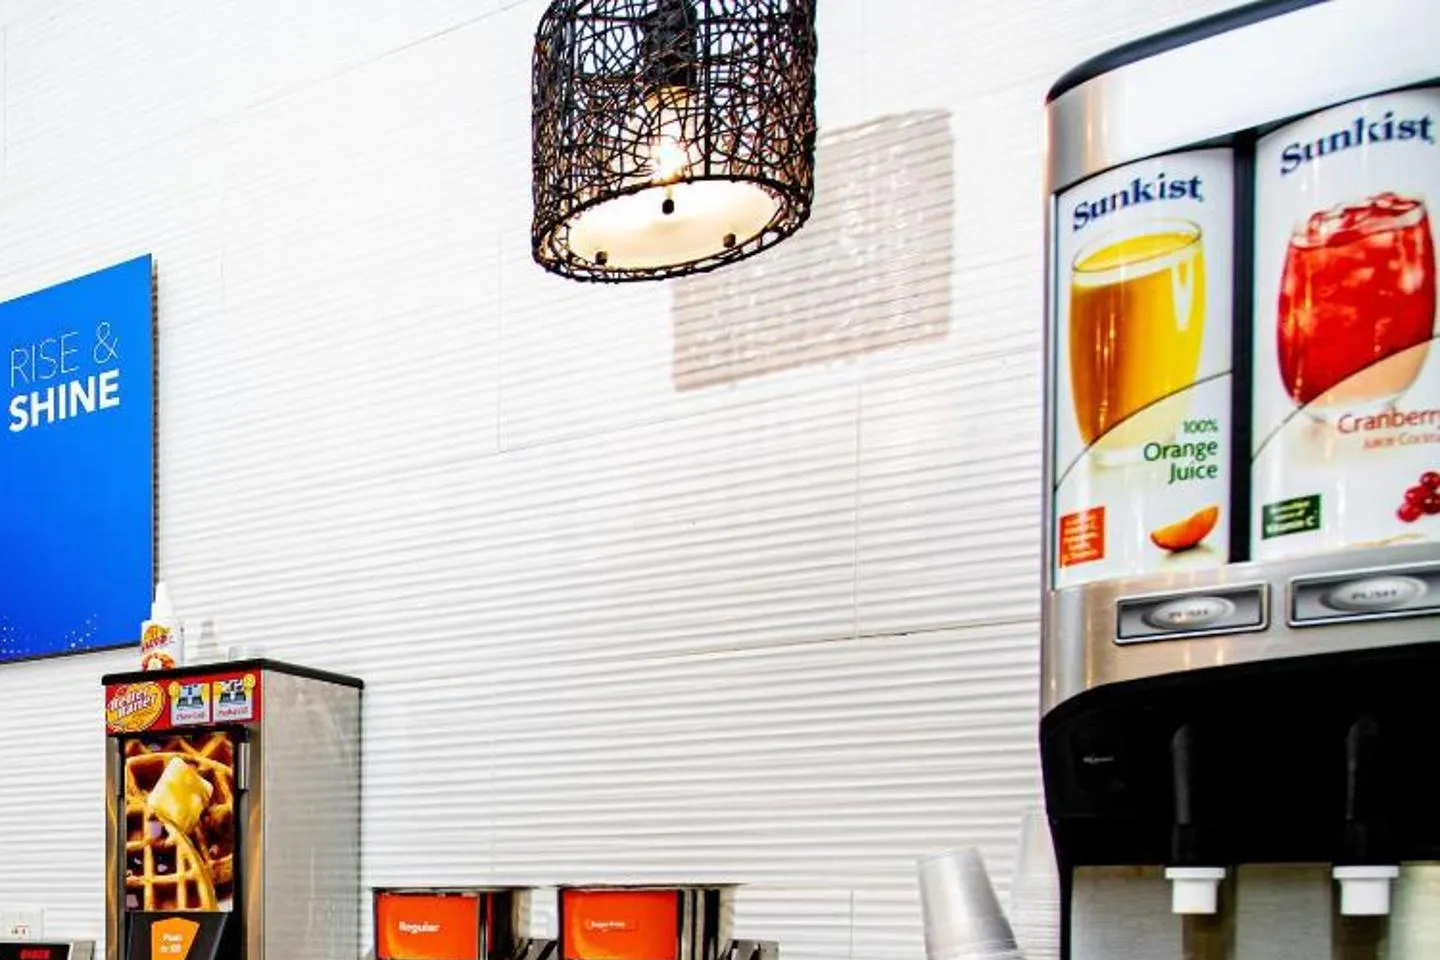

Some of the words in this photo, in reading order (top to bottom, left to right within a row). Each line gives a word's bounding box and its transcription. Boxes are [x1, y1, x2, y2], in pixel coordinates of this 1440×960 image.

[1280, 111, 1435, 176] Sunkist
[1072, 172, 1204, 231] Sunkist
[11, 331, 79, 388] RISE
[93, 321, 119, 364] &
[8, 368, 120, 433] SHINE
[1183, 419, 1219, 433] 100%
[1143, 440, 1219, 462] Orange
[1167, 462, 1219, 485] Juice
